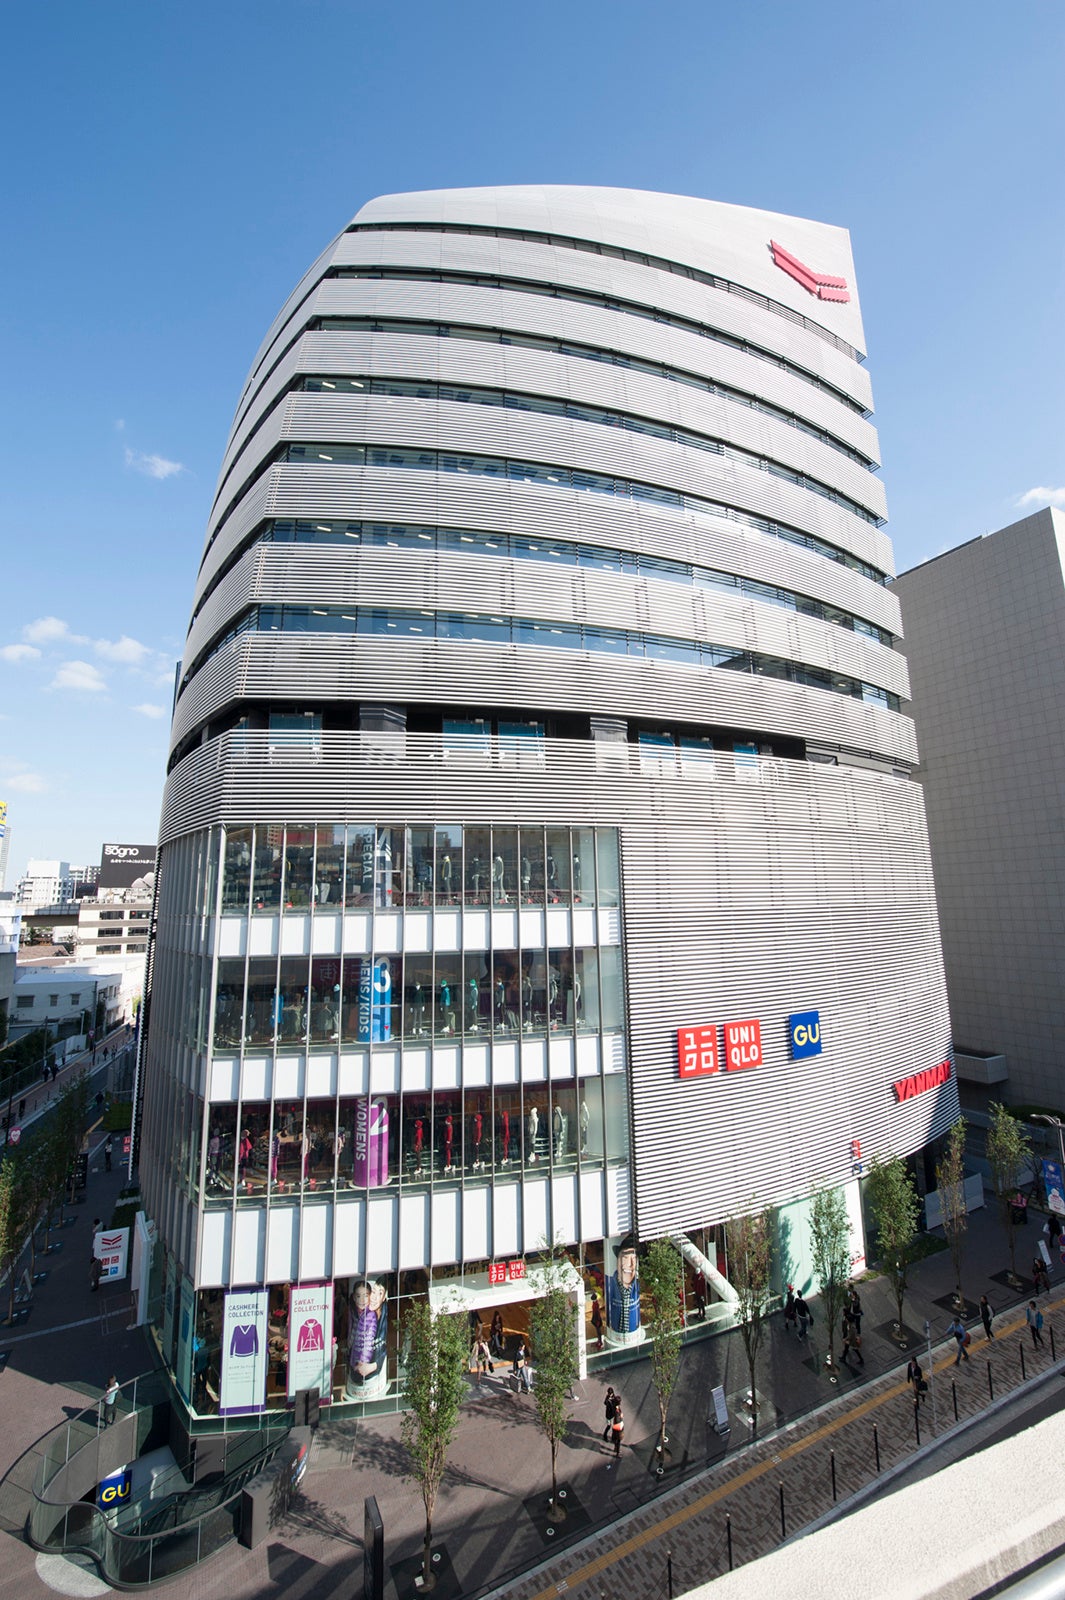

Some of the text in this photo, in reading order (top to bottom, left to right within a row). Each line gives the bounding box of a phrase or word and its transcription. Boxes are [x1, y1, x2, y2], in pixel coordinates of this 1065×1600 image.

[362, 828, 373, 883] SPECIAL
[359, 956, 371, 1034] MENS/KIDS
[684, 1030, 713, 1051] ユニ
[729, 1025, 755, 1045] UNI
[793, 1023, 820, 1046] GU
[684, 1050, 714, 1071] クロ
[731, 1044, 759, 1067] QLO
[355, 1098, 368, 1161] WOMENS
[228, 1303, 259, 1311] CASHMERE
[294, 1298, 315, 1306] SWEAT
[294, 1304, 330, 1313] COLLECTION
[228, 1310, 264, 1318] COLLECTION
[101, 1481, 130, 1503] GU
